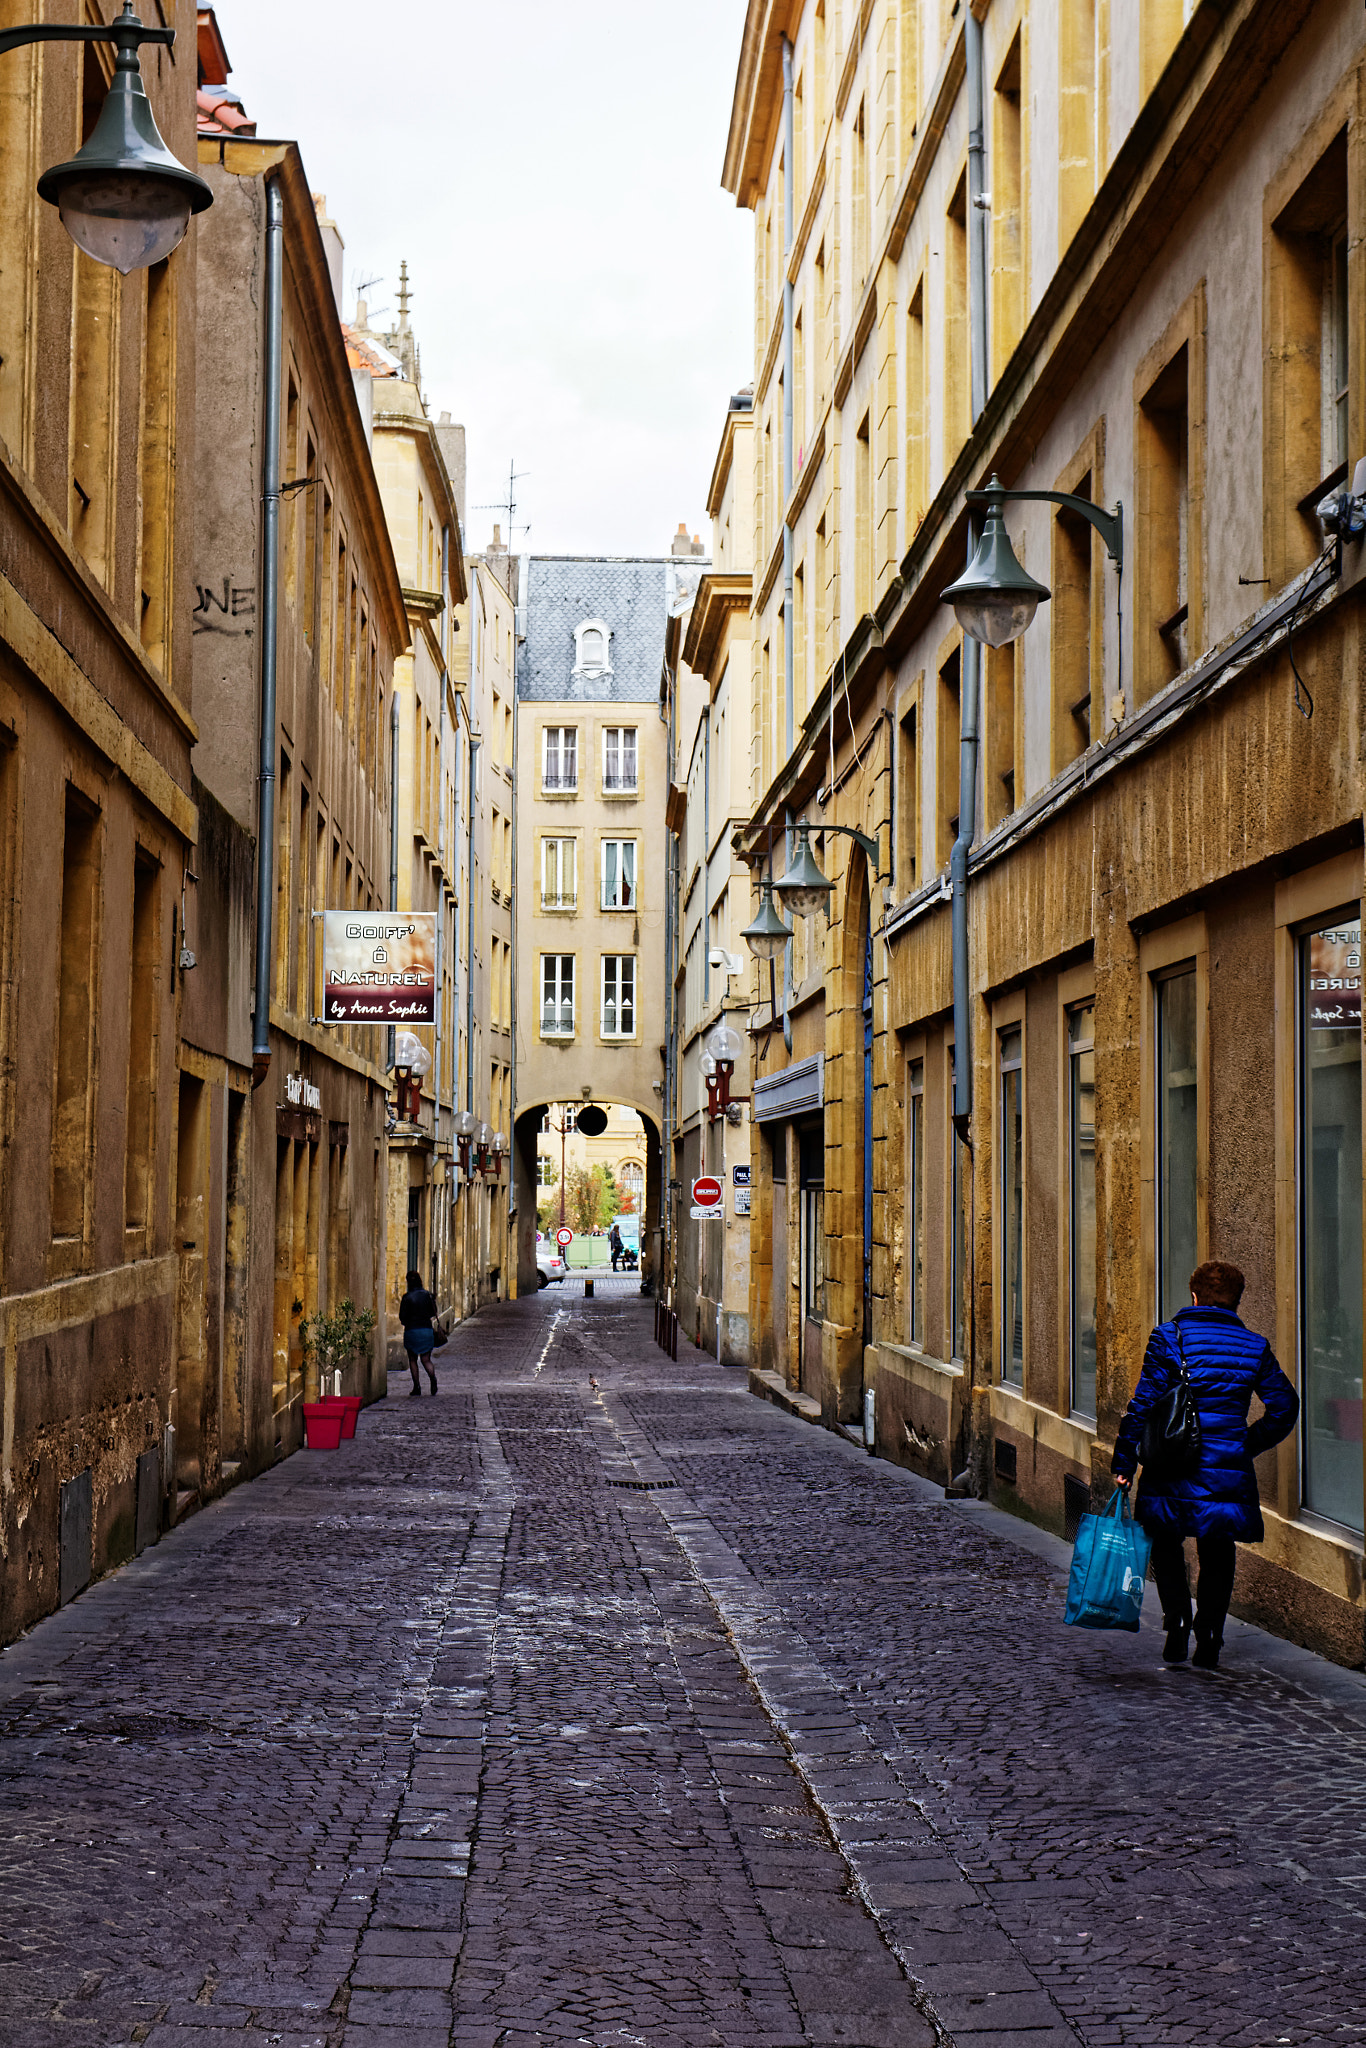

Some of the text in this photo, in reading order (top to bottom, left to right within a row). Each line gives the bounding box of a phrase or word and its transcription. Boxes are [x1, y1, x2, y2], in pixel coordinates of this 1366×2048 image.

[372, 945, 388, 963] Ô
[330, 1000, 428, 1018] by Anne Sophie
